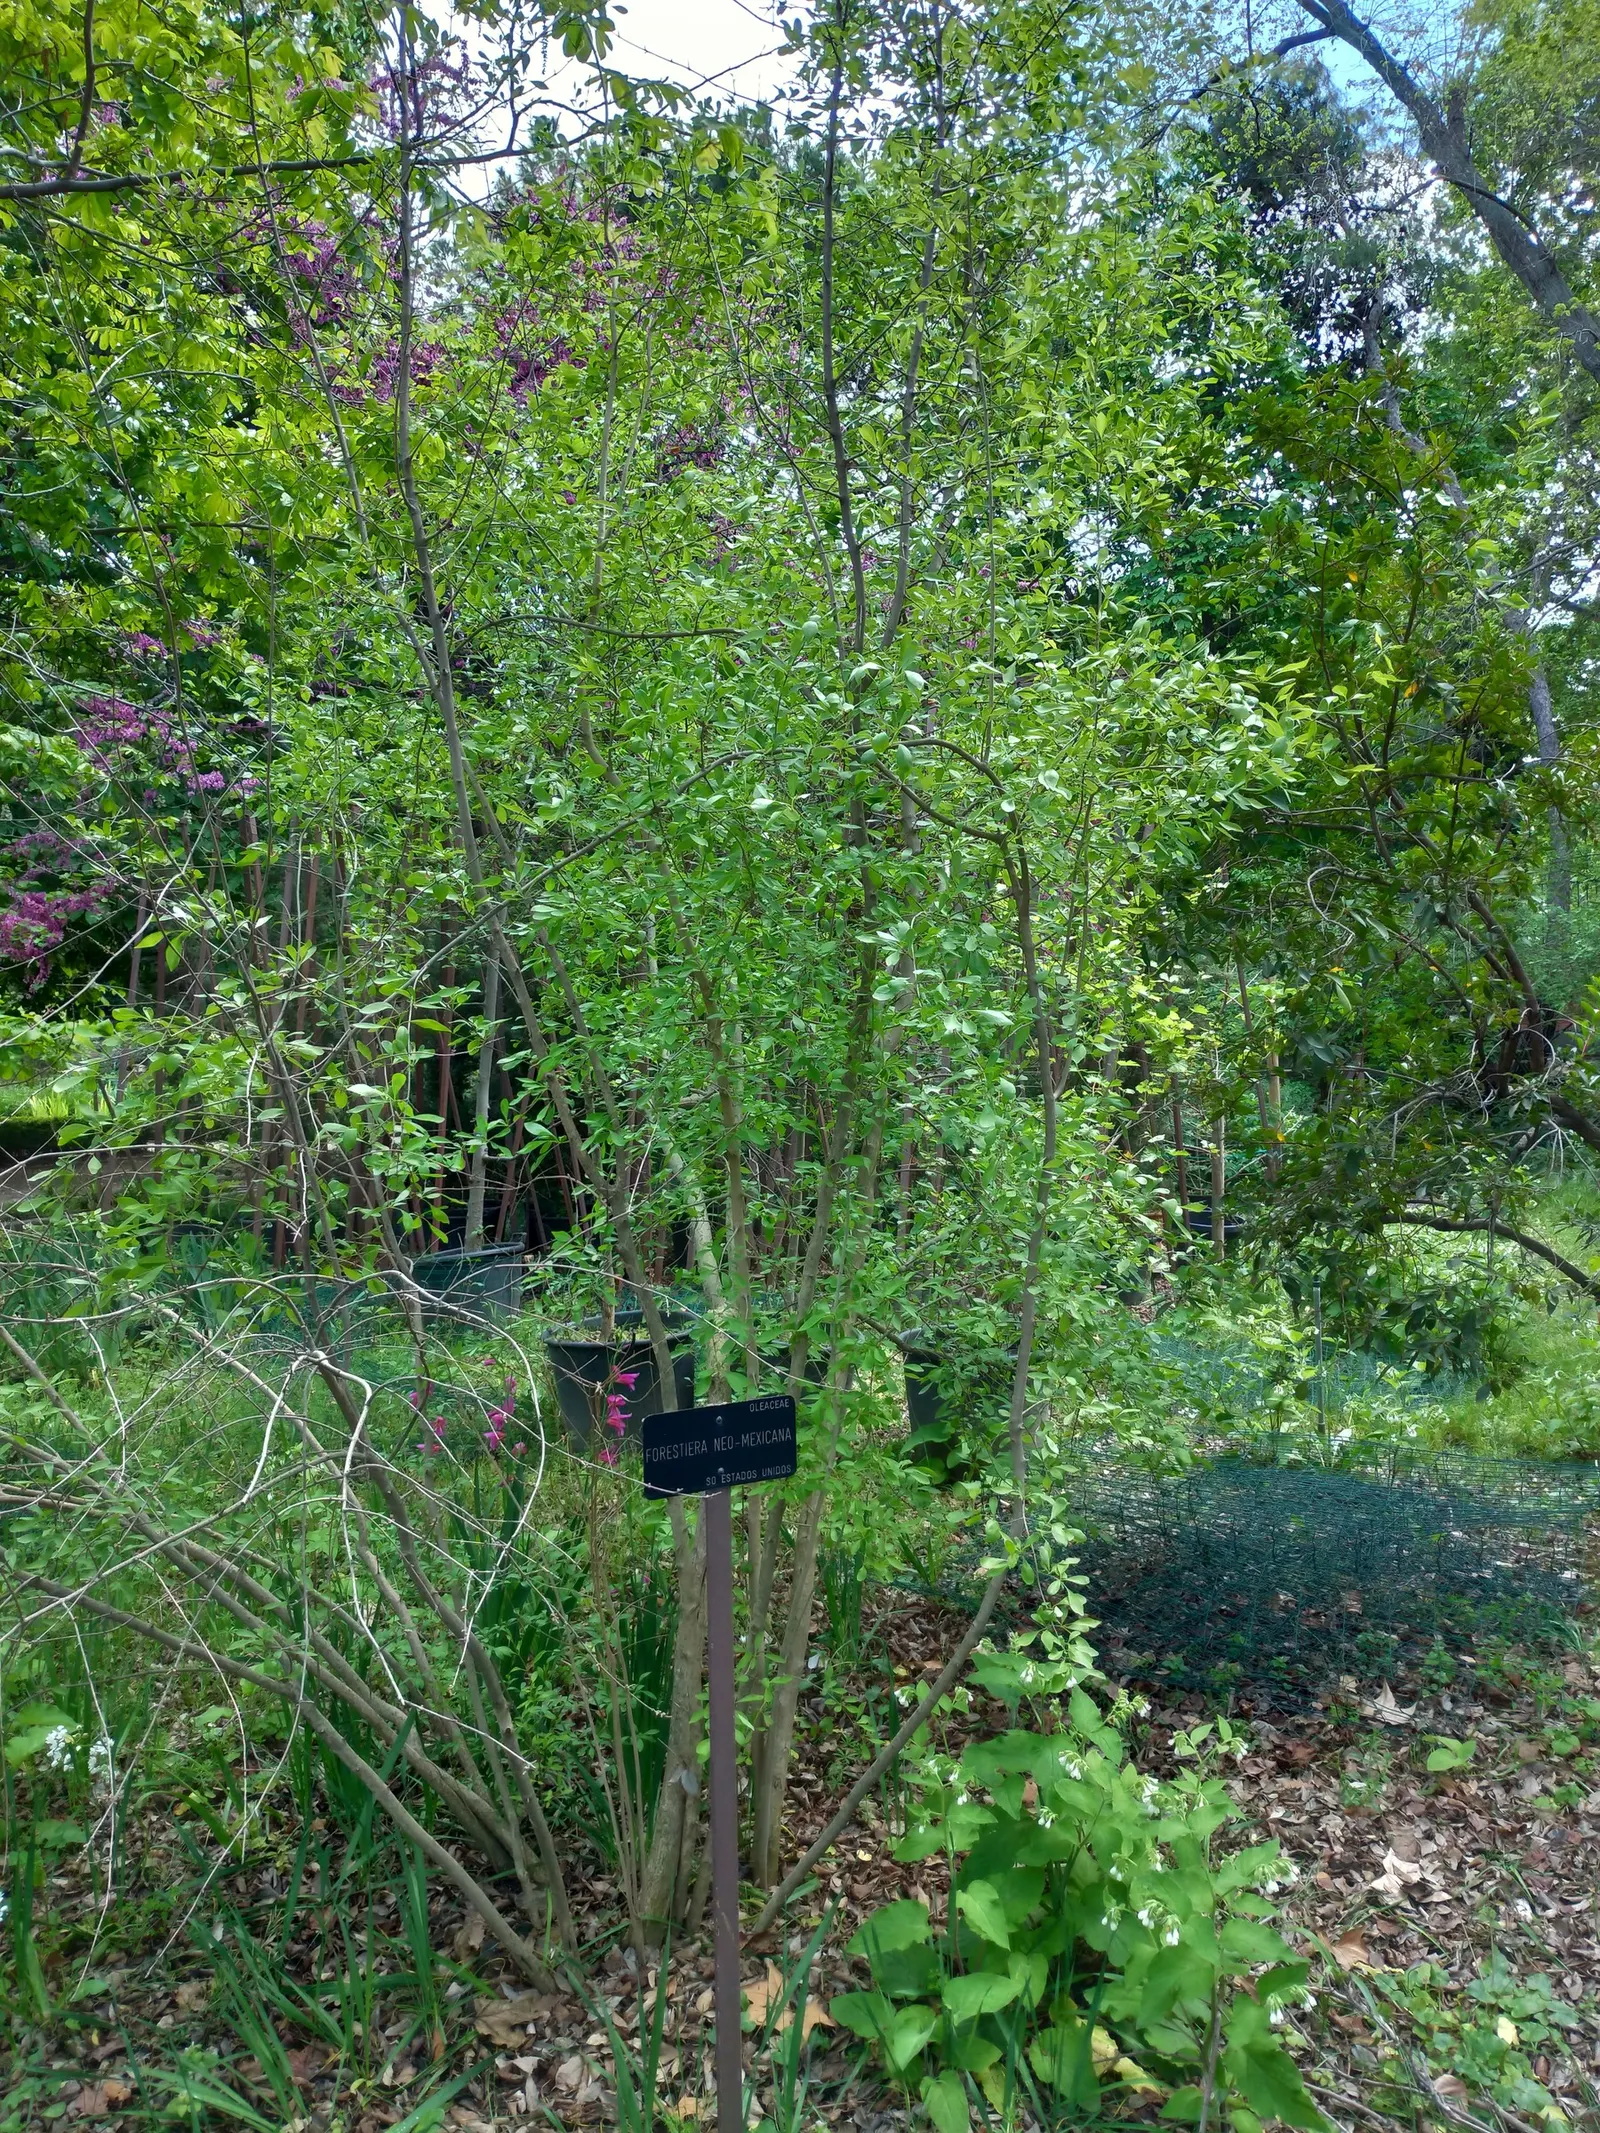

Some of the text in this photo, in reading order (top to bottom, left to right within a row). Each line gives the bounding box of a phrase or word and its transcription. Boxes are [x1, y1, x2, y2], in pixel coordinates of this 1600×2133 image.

[749, 1398, 790, 1412] OLEACEAE
[645, 1427, 792, 1463] FORESTIERA NEO-MEXICANA
[721, 1470, 758, 1484] ESTADOS
[761, 1464, 792, 1477] UNIDOS
